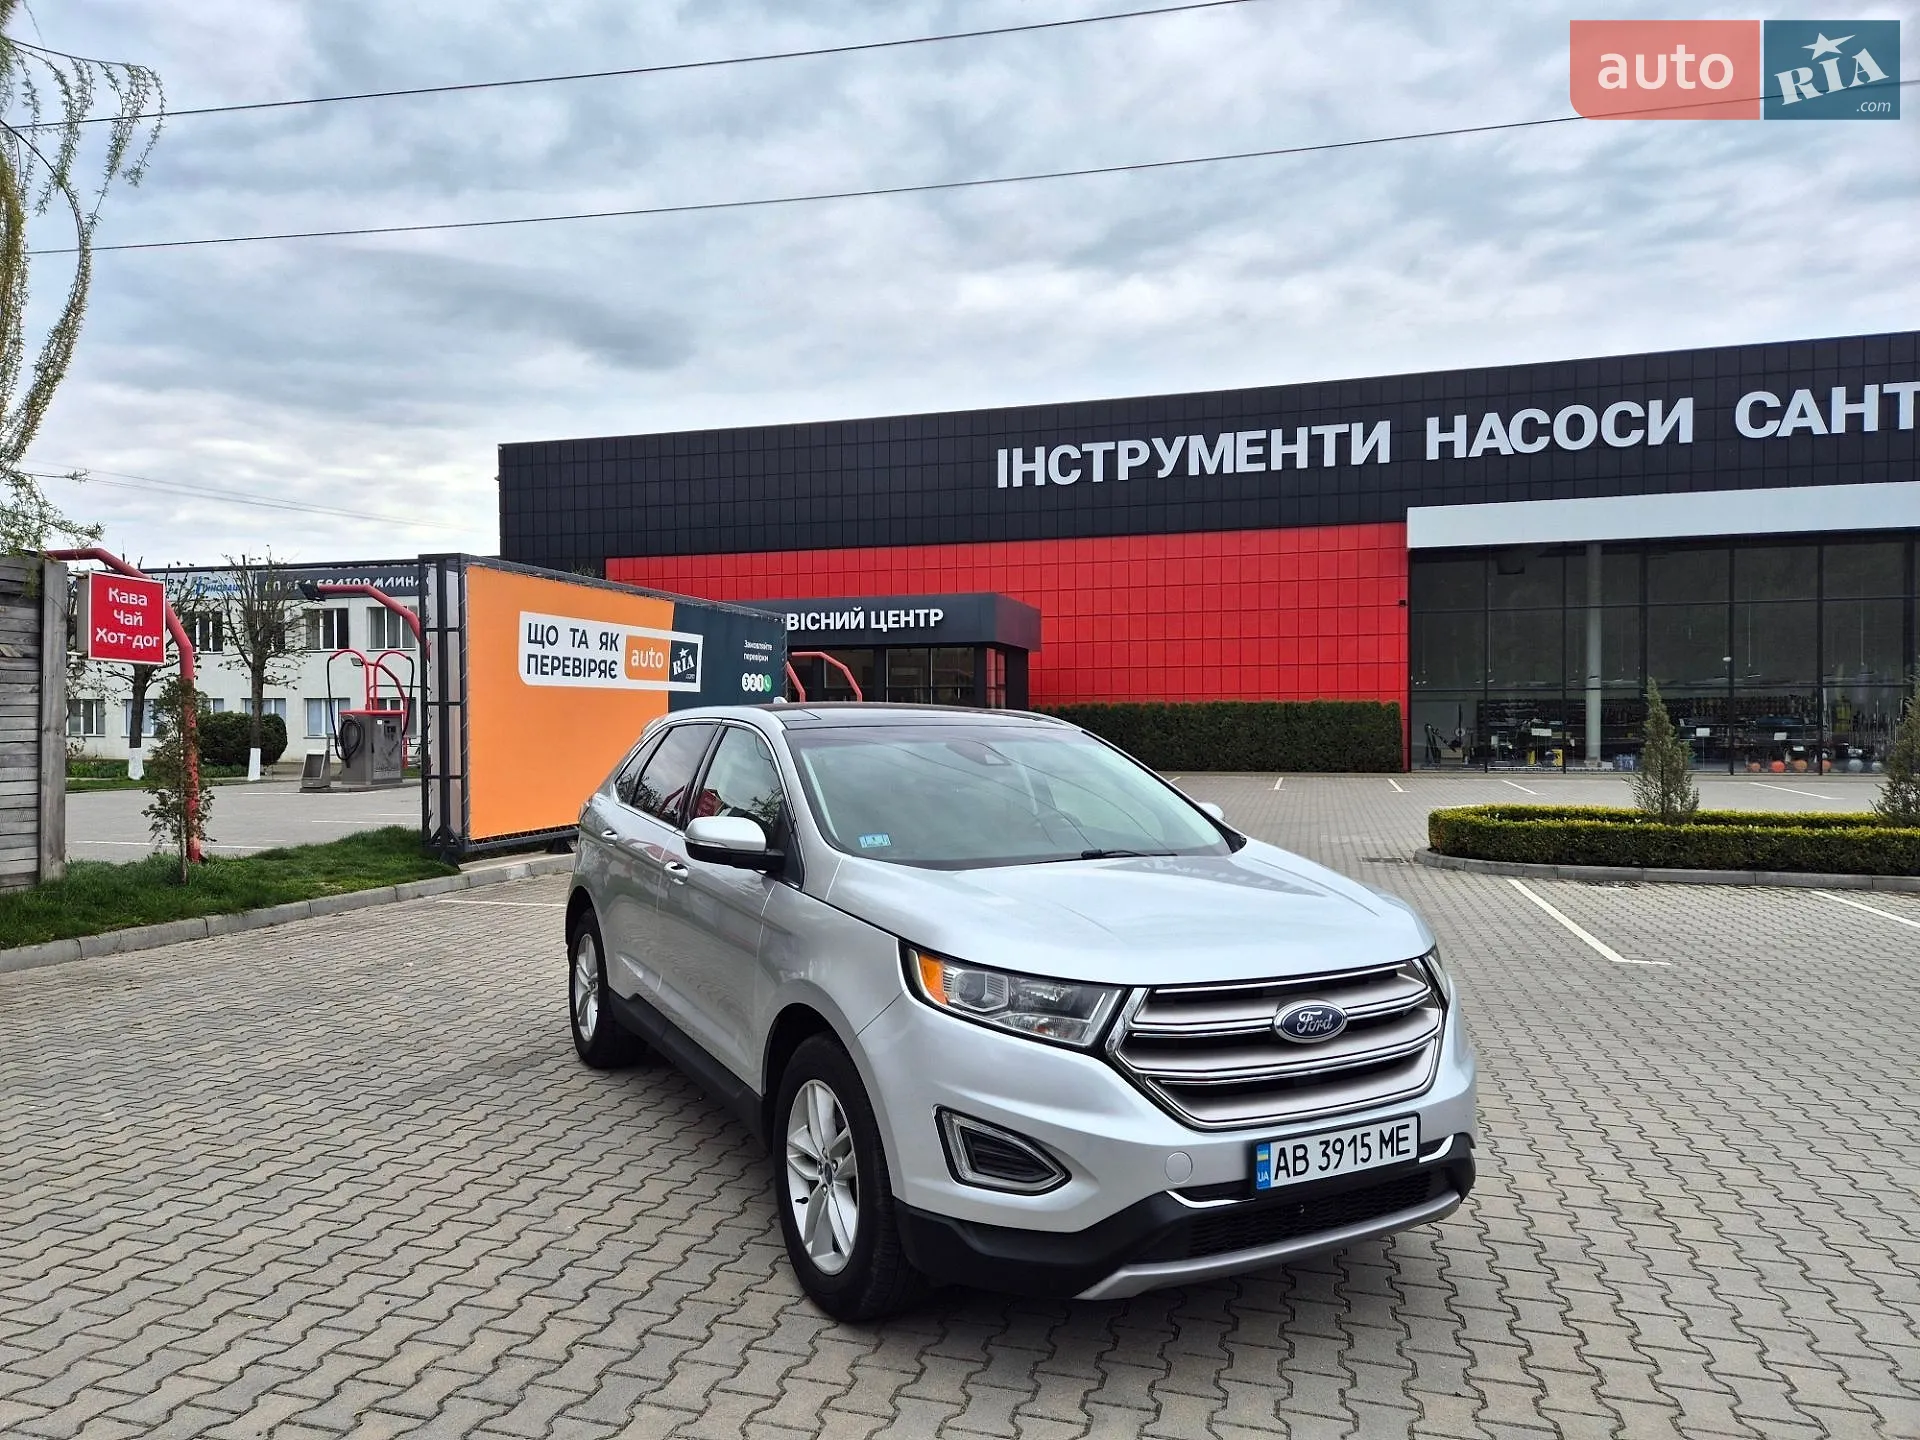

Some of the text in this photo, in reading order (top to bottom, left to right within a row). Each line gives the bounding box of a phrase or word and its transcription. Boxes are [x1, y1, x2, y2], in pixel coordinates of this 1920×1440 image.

[997, 381, 1920, 489] ІНСТРУМЕНТИ НАСОСИ САНТ
[108, 587, 148, 606] Кава
[113, 609, 143, 626] Чай
[870, 609, 944, 632] ЦЕНТР
[95, 627, 160, 649] Хот-дог
[527, 622, 620, 652] ЩО ТА ЯК
[526, 653, 618, 679] ПЕРЕВІРЯЄ
[631, 648, 664, 669] auto
[673, 655, 695, 676] RIA
[1296, 1010, 1334, 1034] Ford
[1274, 1123, 1411, 1181] AB 3915 ME
[1257, 1171, 1270, 1183] UA
